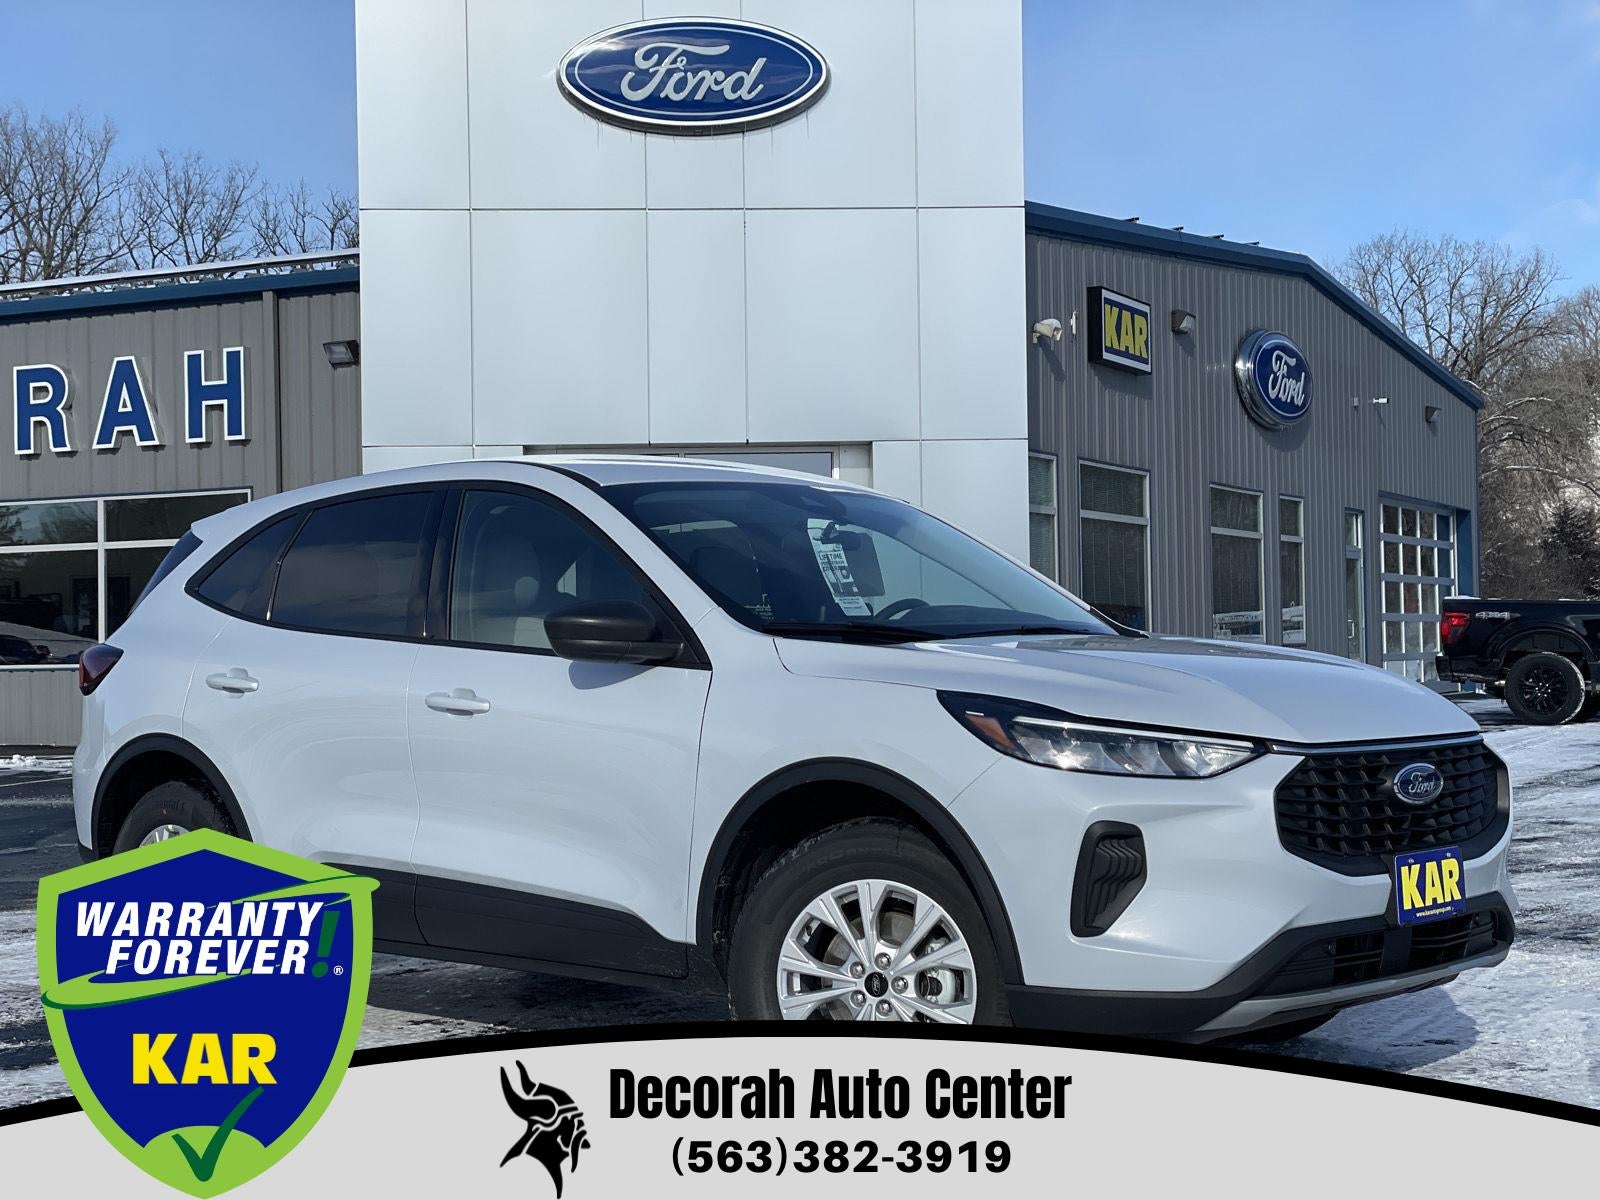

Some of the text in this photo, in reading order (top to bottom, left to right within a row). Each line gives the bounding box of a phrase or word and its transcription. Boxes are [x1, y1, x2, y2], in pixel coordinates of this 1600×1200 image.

[620, 42, 767, 101] Ford
[1104, 303, 1148, 359] KAR
[13, 346, 246, 455] RAH
[1268, 350, 1305, 406] Ford
[818, 553, 844, 562] LIFTIME
[1408, 771, 1435, 794] Ford
[1400, 857, 1462, 910] KAR
